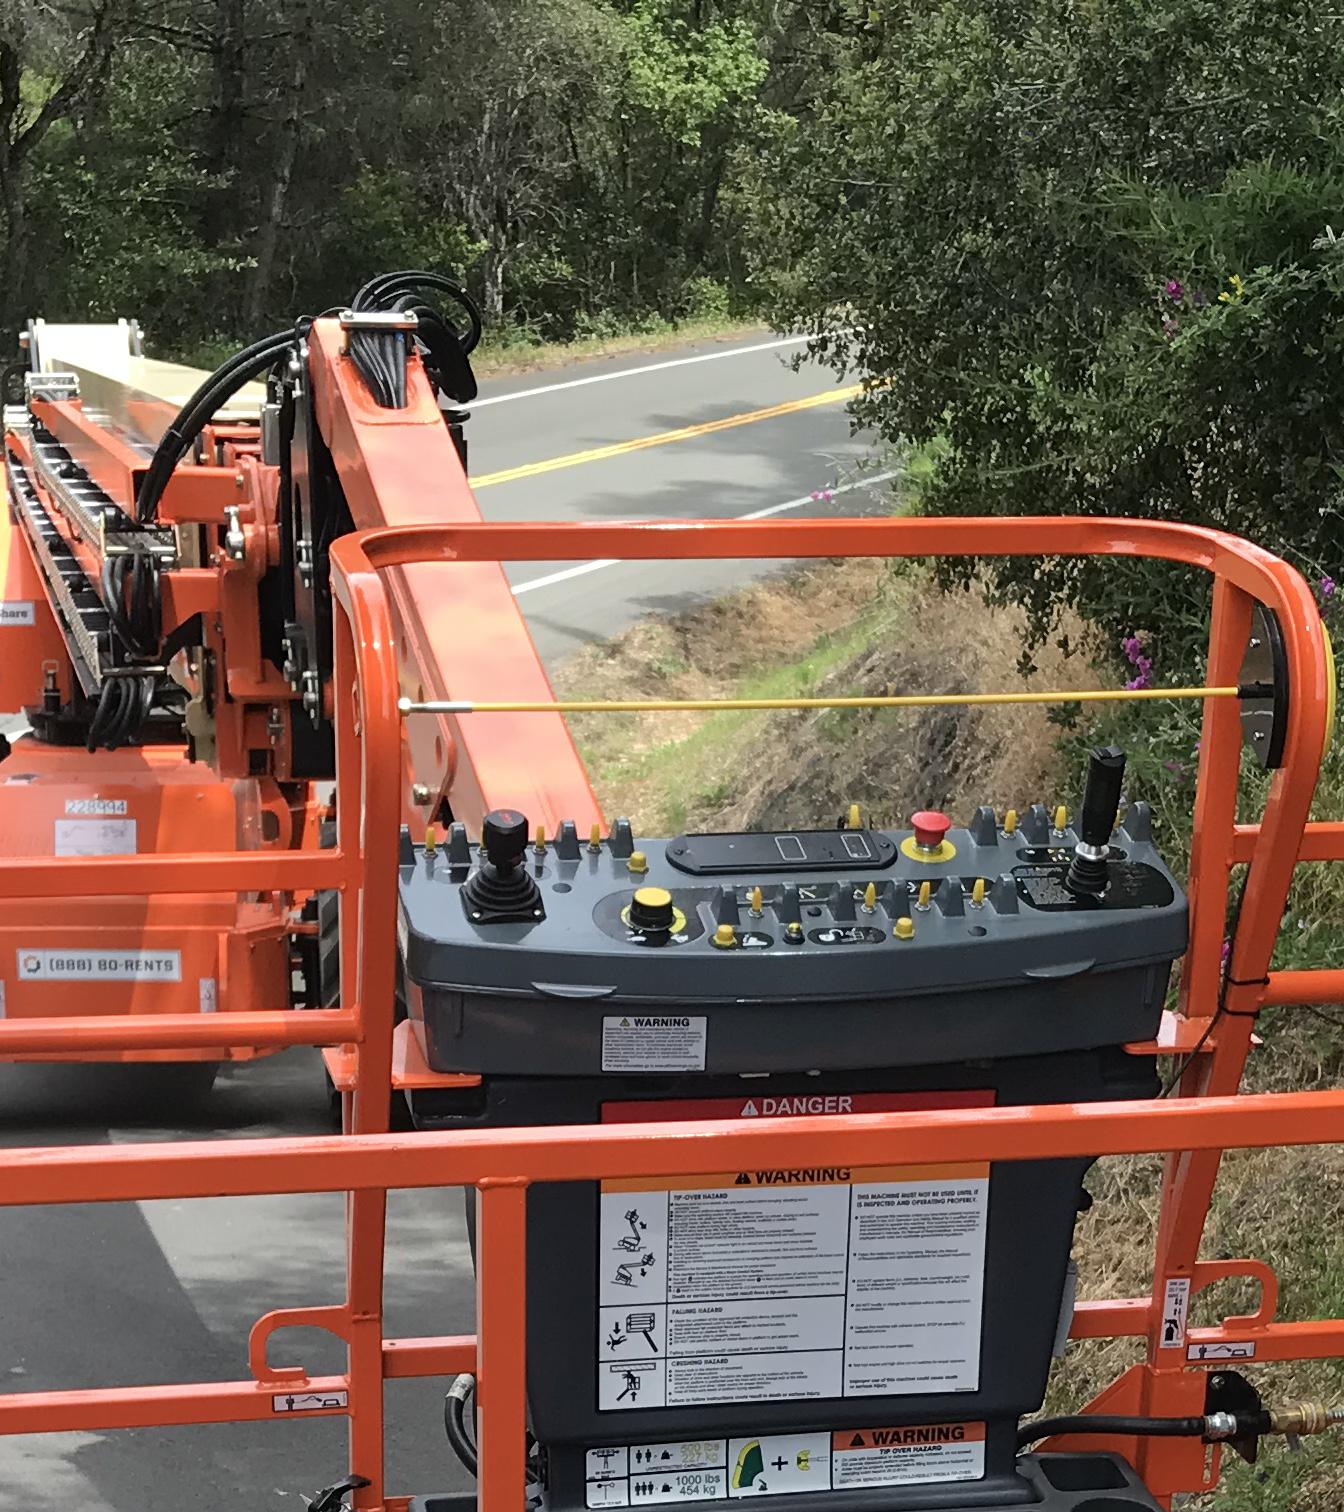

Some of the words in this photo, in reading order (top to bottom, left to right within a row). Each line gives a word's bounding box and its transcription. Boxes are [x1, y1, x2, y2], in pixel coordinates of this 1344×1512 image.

[49, 958, 92, 972] (888)
[97, 958, 174, 972] 80-RENTS
[634, 1018, 690, 1027] WARNING
[762, 1096, 853, 1116] DANGER
[756, 1168, 851, 1185] WARNING
[872, 1424, 965, 1446] WARNING
[913, 1444, 942, 1452] HAZARD
[676, 1474, 702, 1486] 1000
[705, 1473, 720, 1484] lbs
[679, 1485, 699, 1495] 454
[703, 1484, 716, 1496] kg
